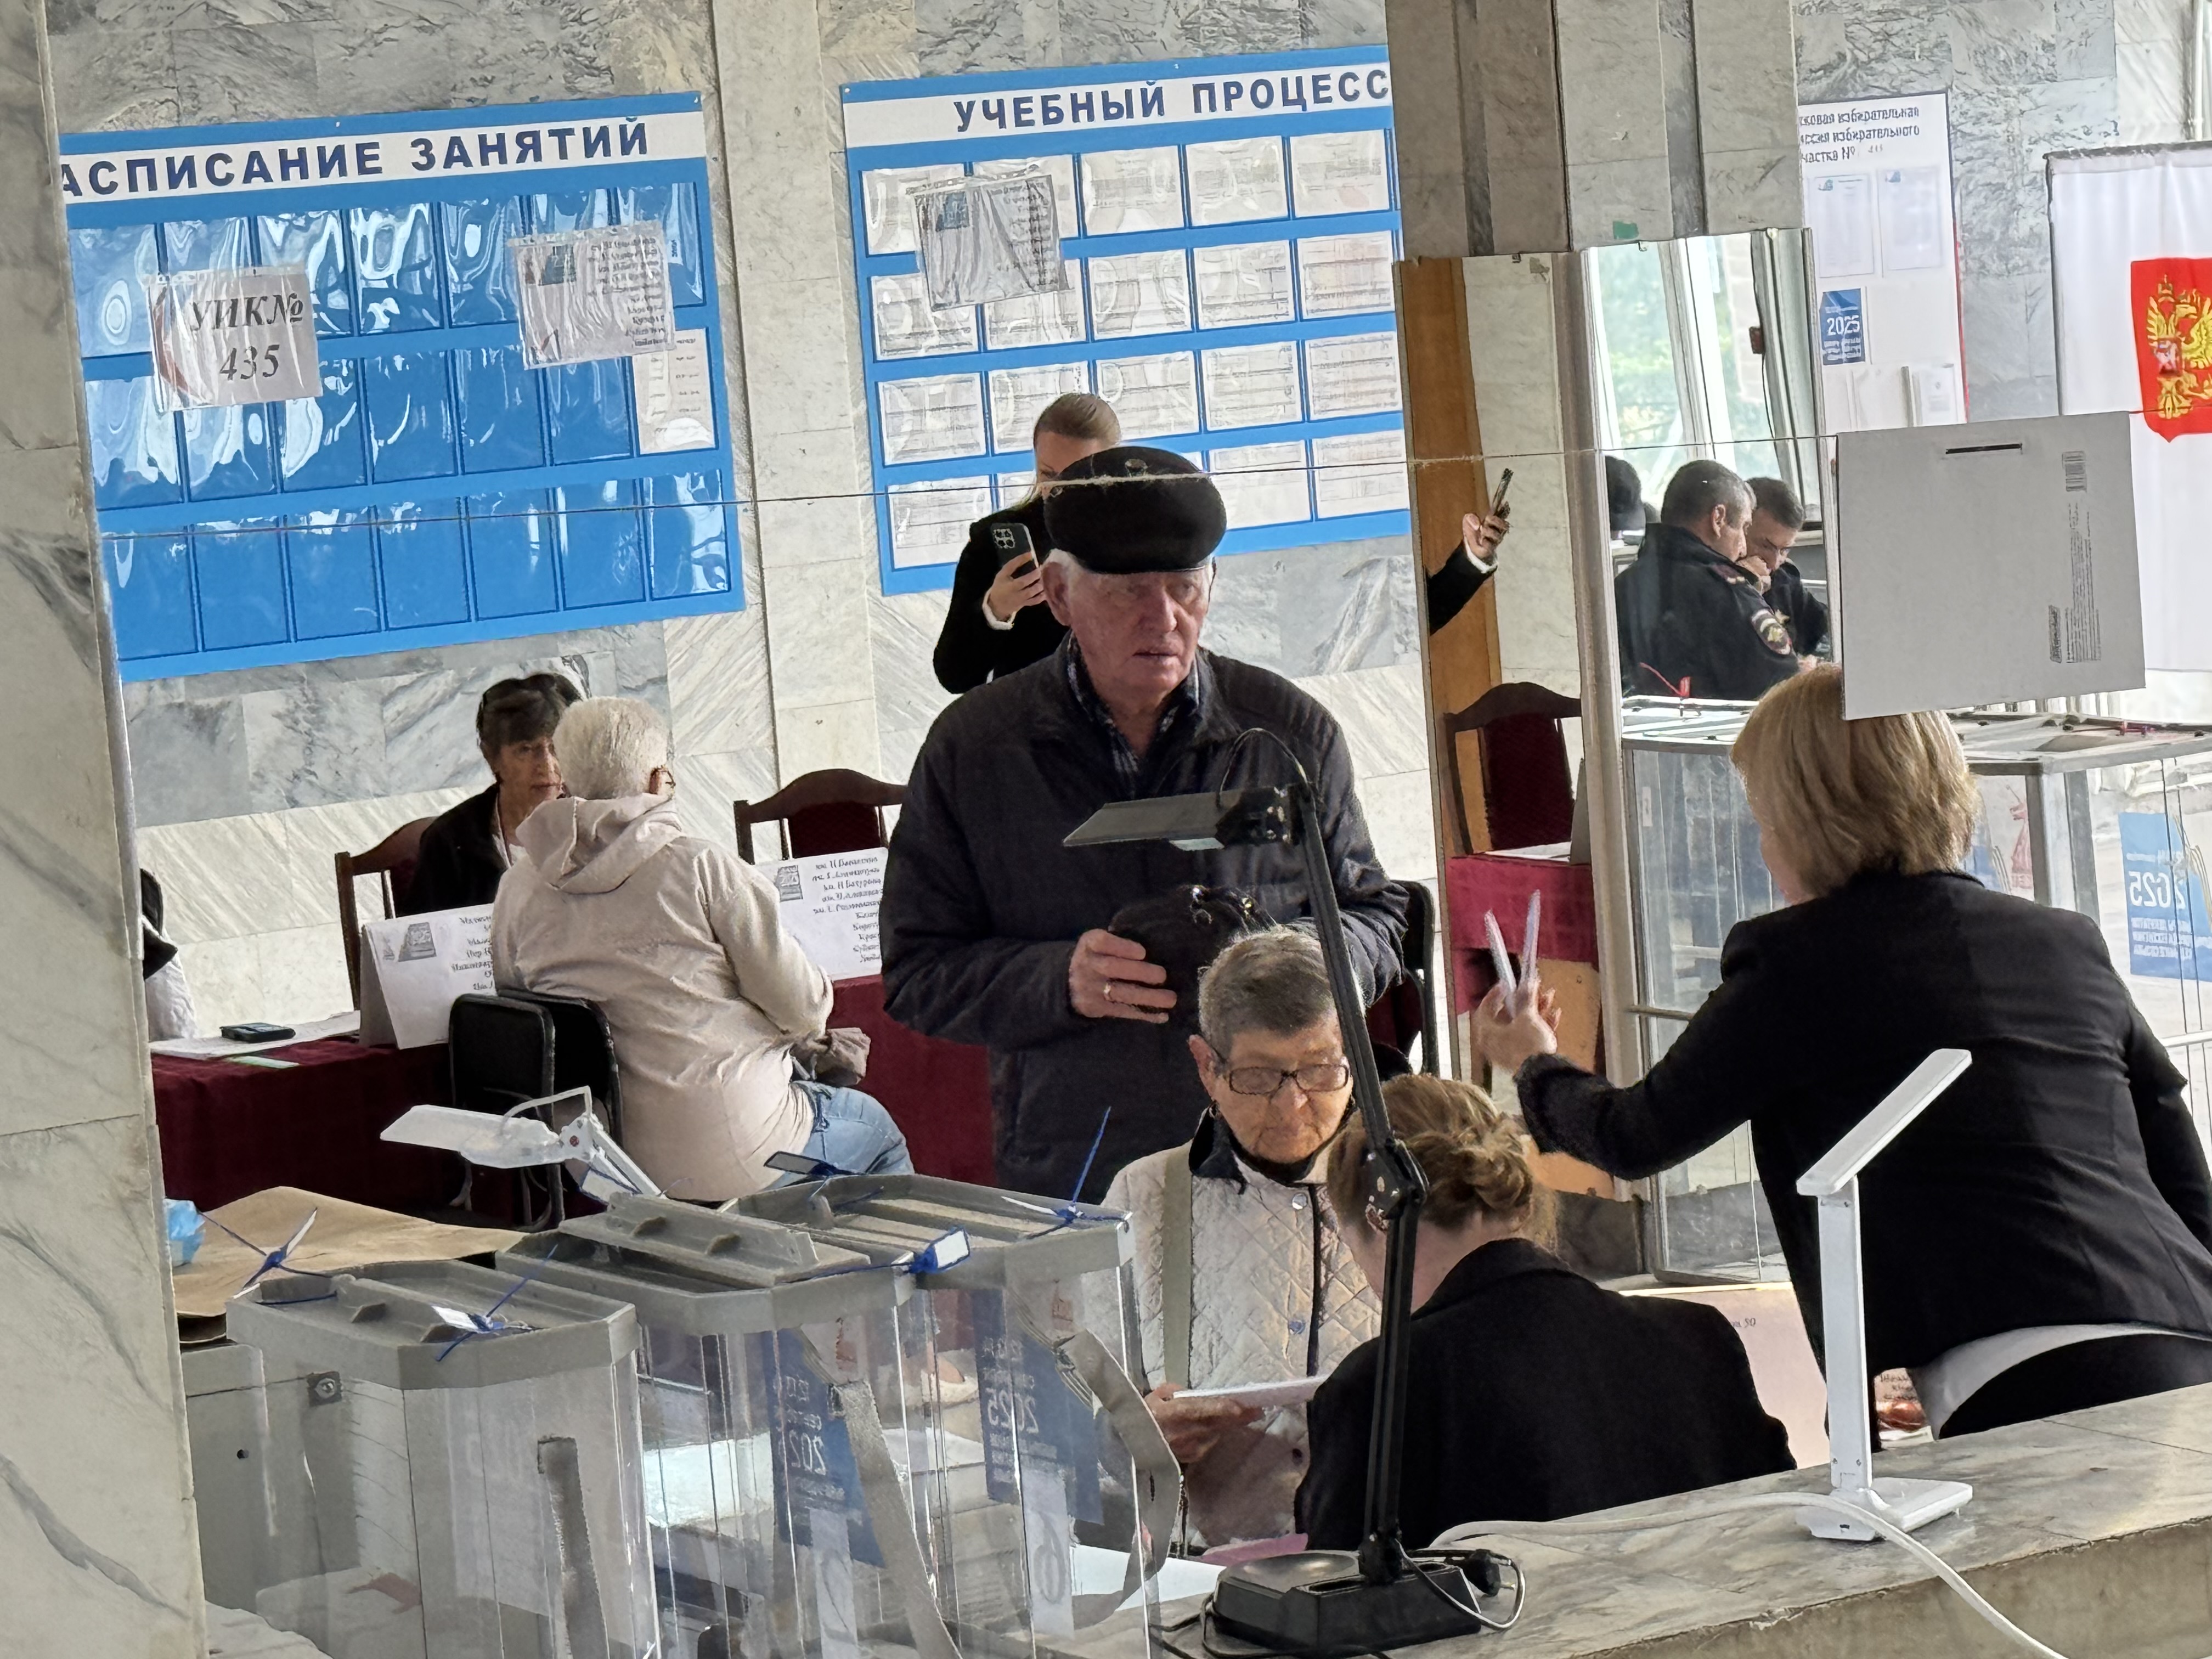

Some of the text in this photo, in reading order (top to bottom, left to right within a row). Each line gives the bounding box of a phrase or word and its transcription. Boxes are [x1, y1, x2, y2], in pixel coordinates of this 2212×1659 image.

[953, 69, 1388, 133] УЧЕБНЫЙ ПРОЦЕСС
[61, 116, 647, 196] АСПИСАНИЕ ЗАНЯТИЙ
[1826, 314, 1860, 336] 2025
[219, 344, 280, 381] 435
